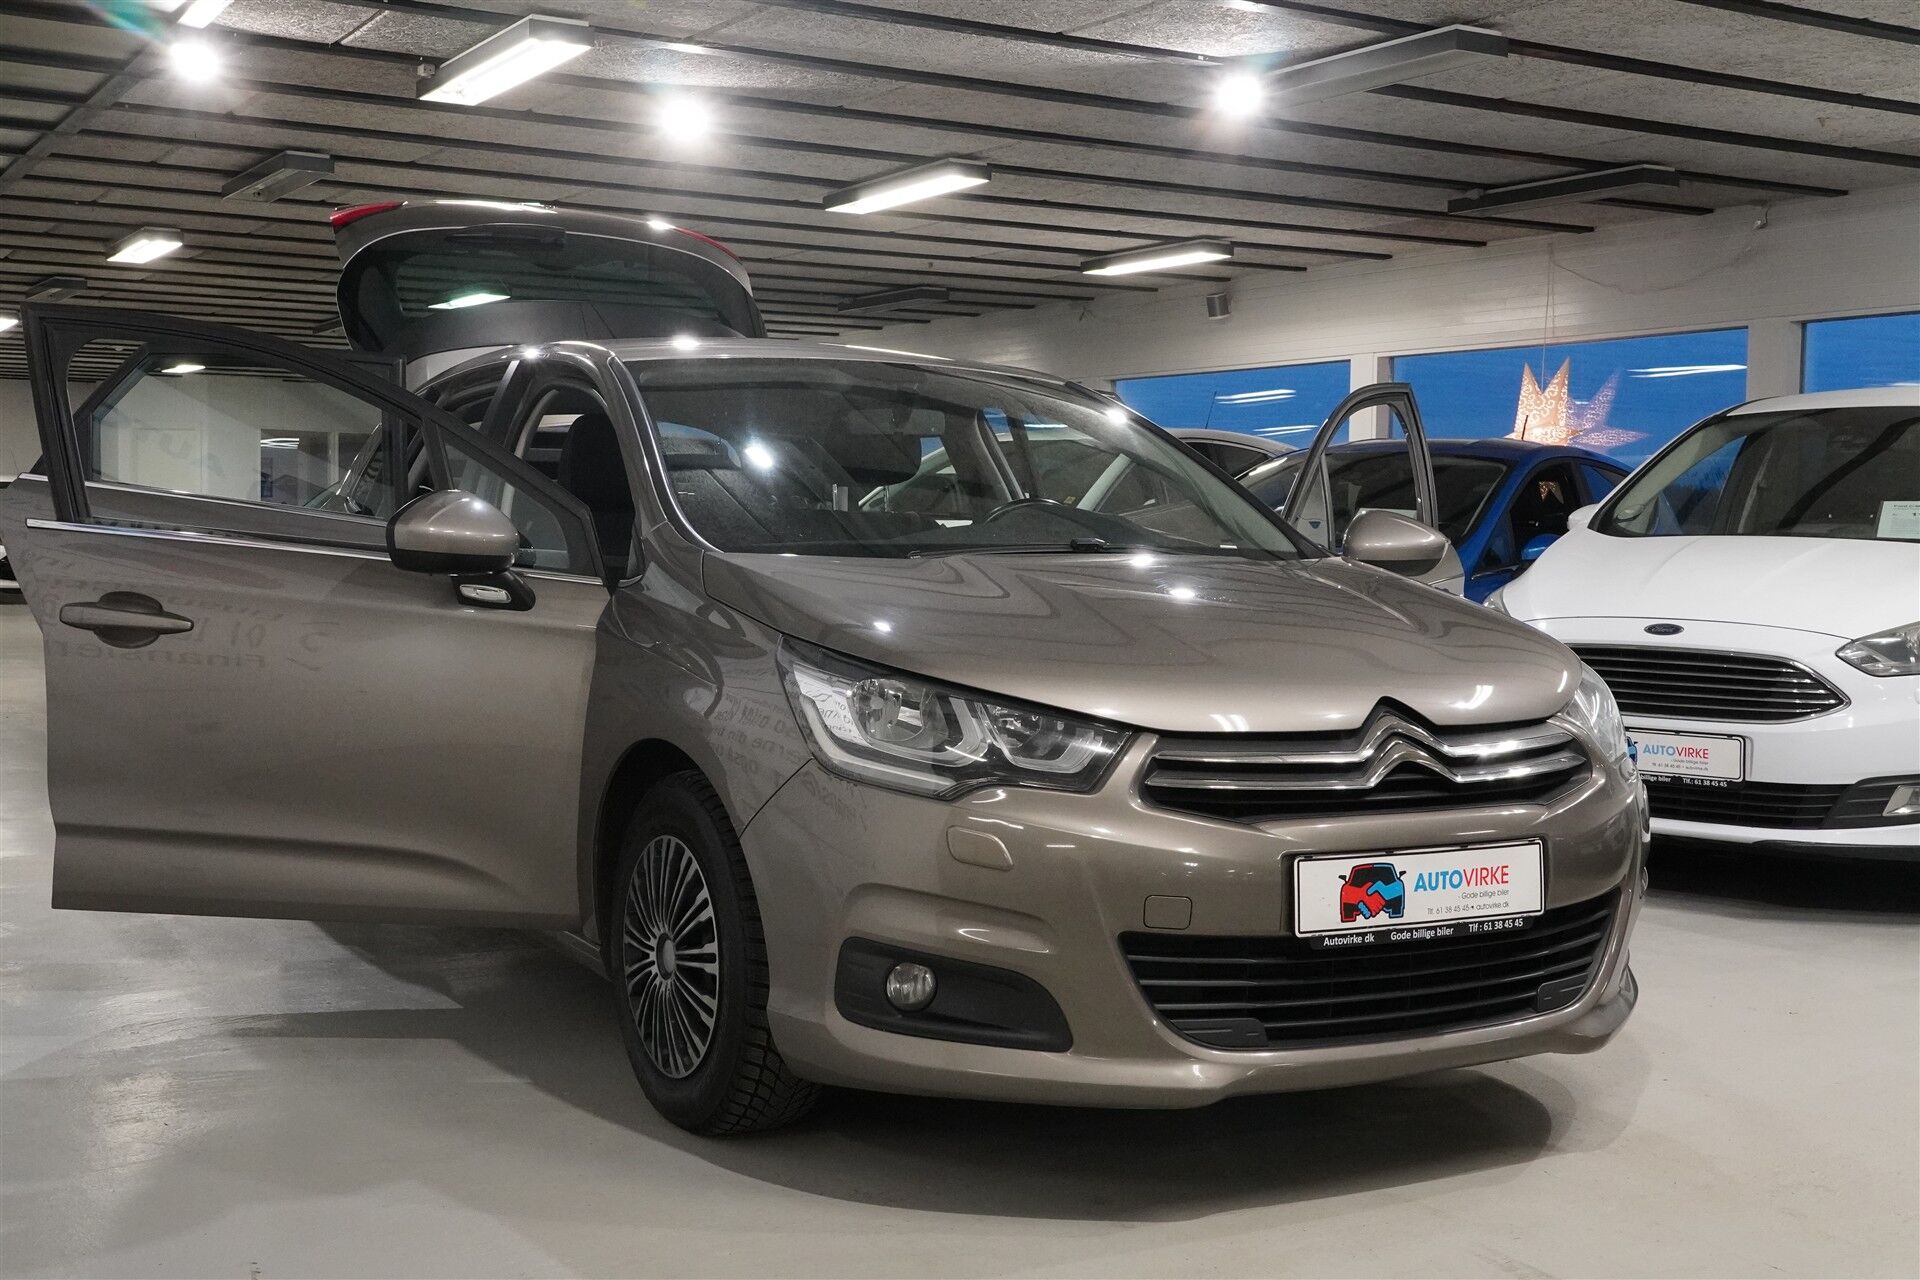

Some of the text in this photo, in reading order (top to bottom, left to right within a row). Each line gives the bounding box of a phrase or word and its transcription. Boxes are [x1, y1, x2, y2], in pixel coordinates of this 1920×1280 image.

[1643, 744, 1709, 759] AUTOVIRKE
[1414, 865, 1509, 892] AUTOVIRKE
[1462, 888, 1510, 900] Gode billige biler
[1445, 906, 1452, 914] 38
[1454, 904, 1461, 912] 45
[1462, 904, 1470, 912] 45
[1483, 921, 1492, 931] 61
[1494, 920, 1503, 930] 38
[1504, 919, 1513, 928] 45
[1514, 918, 1523, 928] 45
[1323, 934, 1362, 946] Autovirke
[1390, 926, 1454, 941] Gode billige biler
